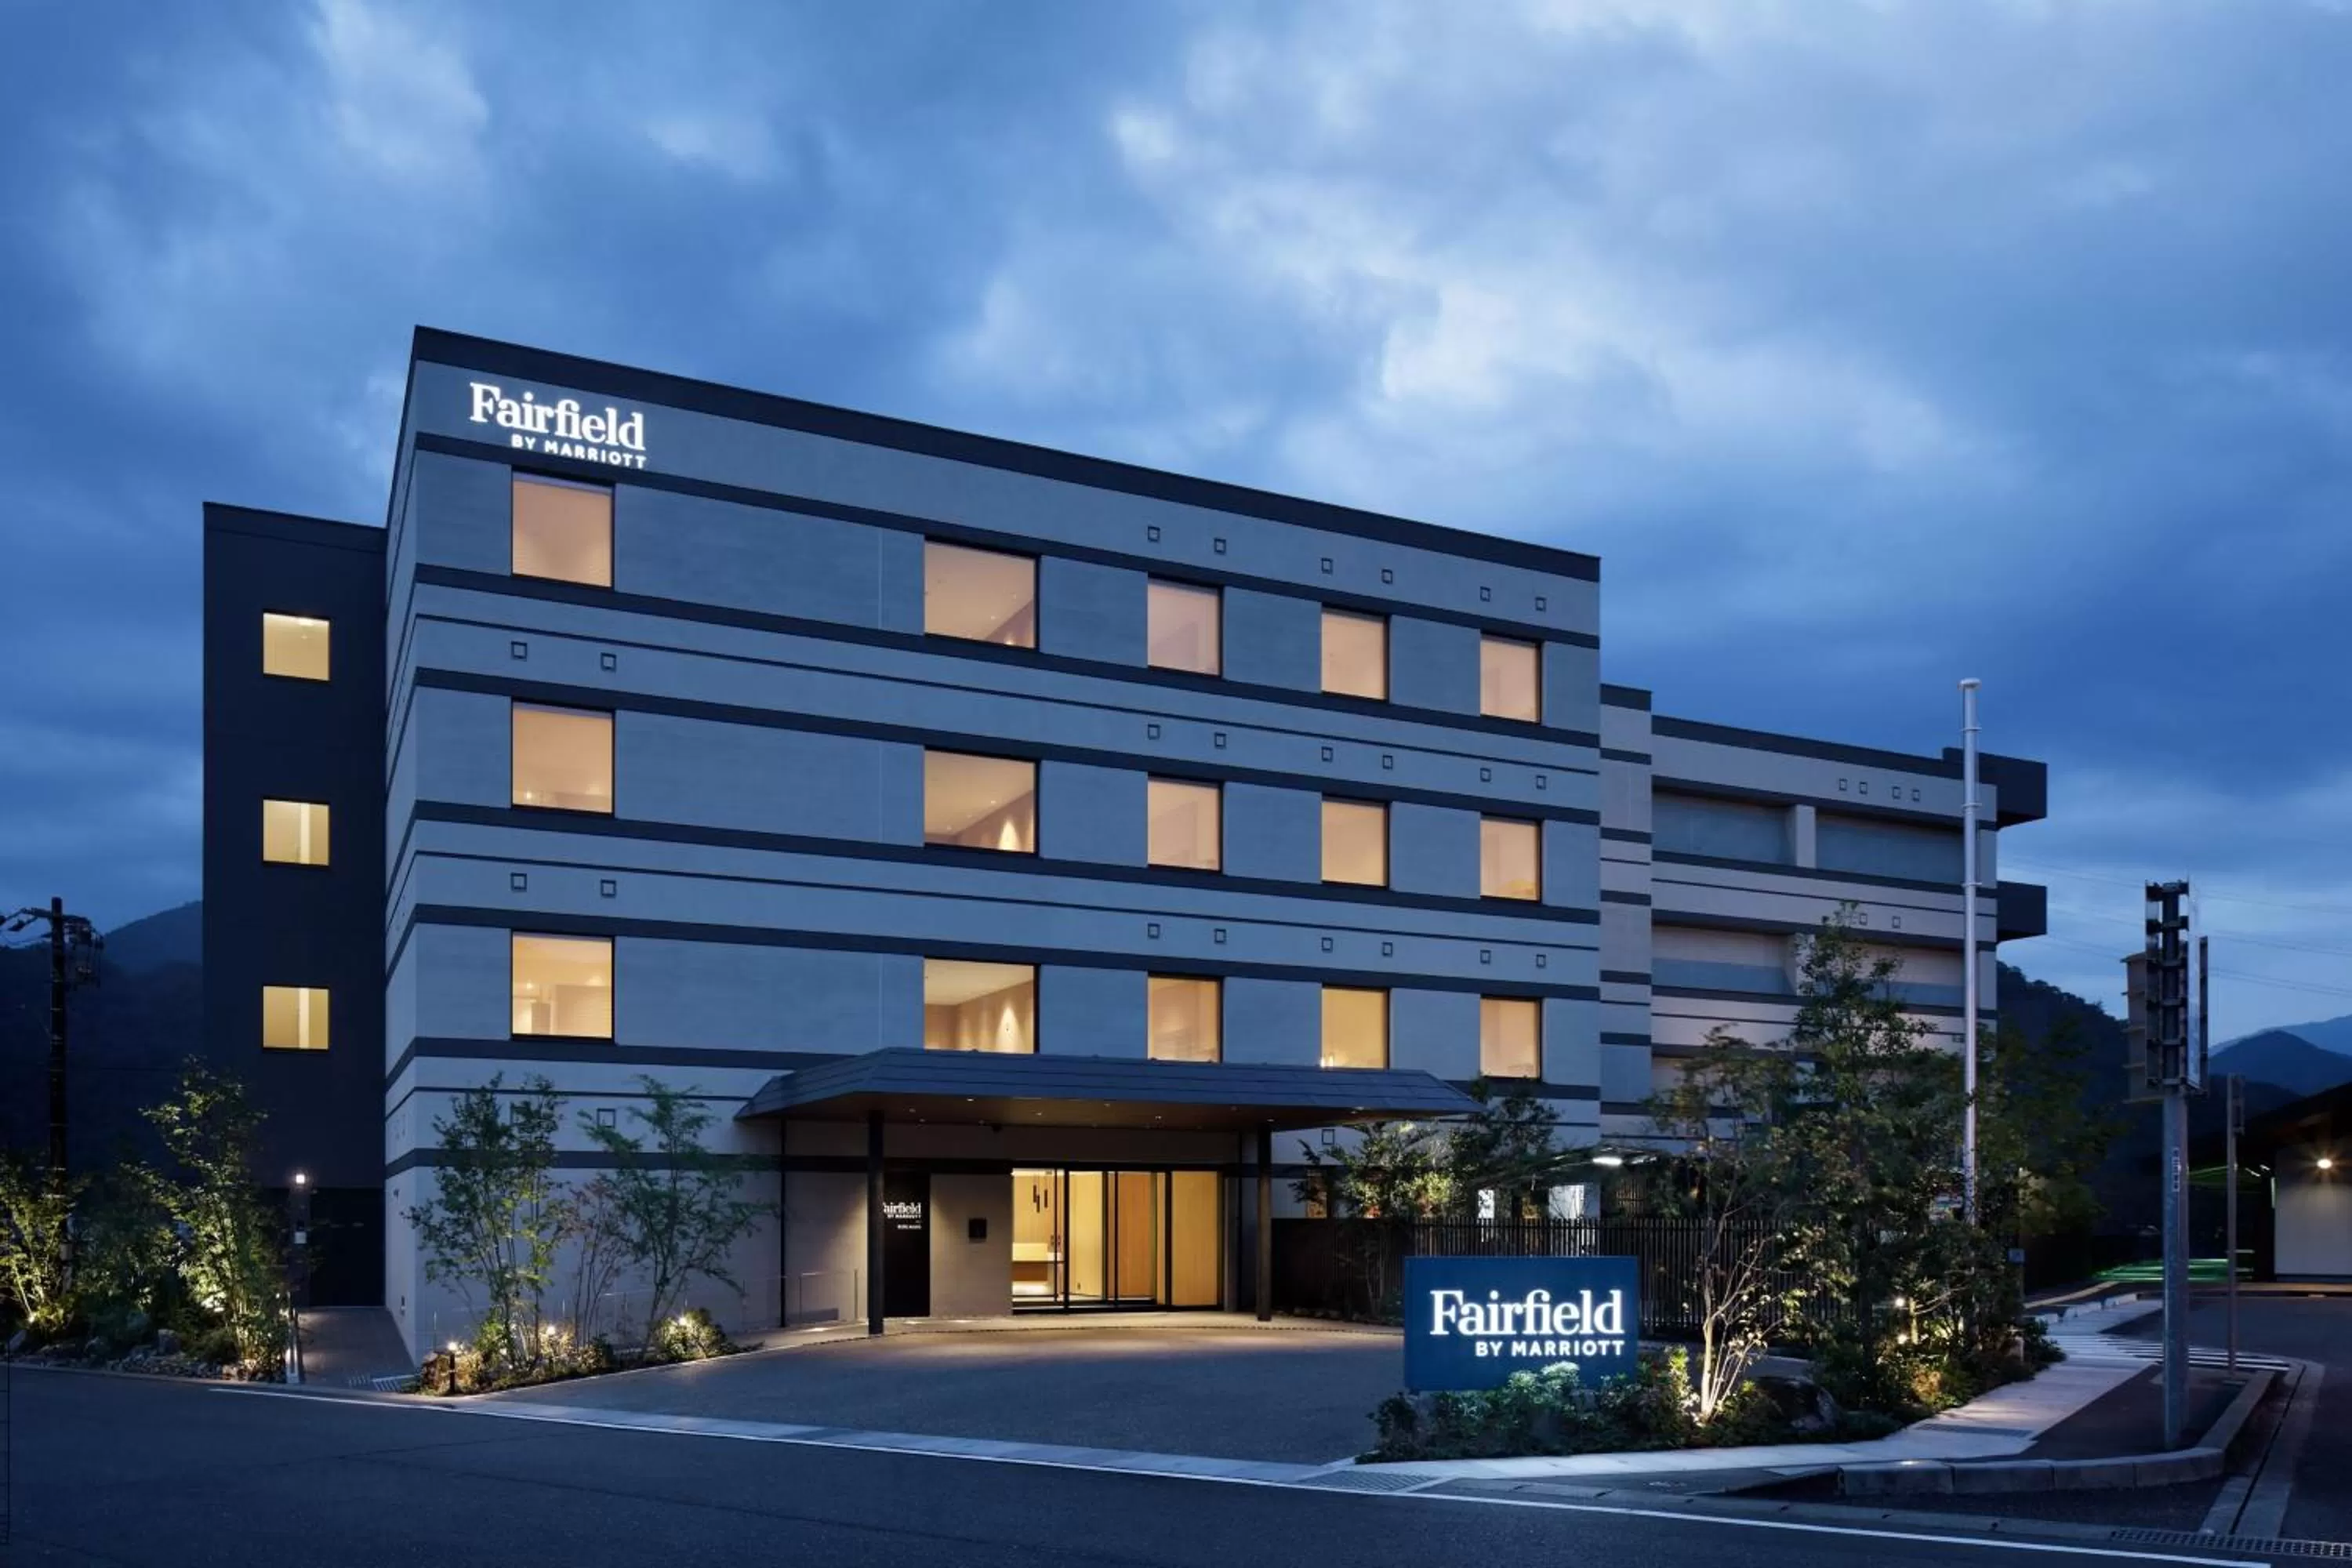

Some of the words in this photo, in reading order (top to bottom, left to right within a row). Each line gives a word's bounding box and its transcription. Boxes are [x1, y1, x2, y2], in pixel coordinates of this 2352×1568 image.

[469, 382, 646, 451] Fairfield
[511, 434, 536, 451] BY
[544, 440, 647, 470] MARRIOTT
[883, 1202, 921, 1214] airfield
[1429, 1289, 1625, 1335] Fairfield
[1475, 1341, 1503, 1357] BY
[1511, 1340, 1624, 1357] MARRIOTT
